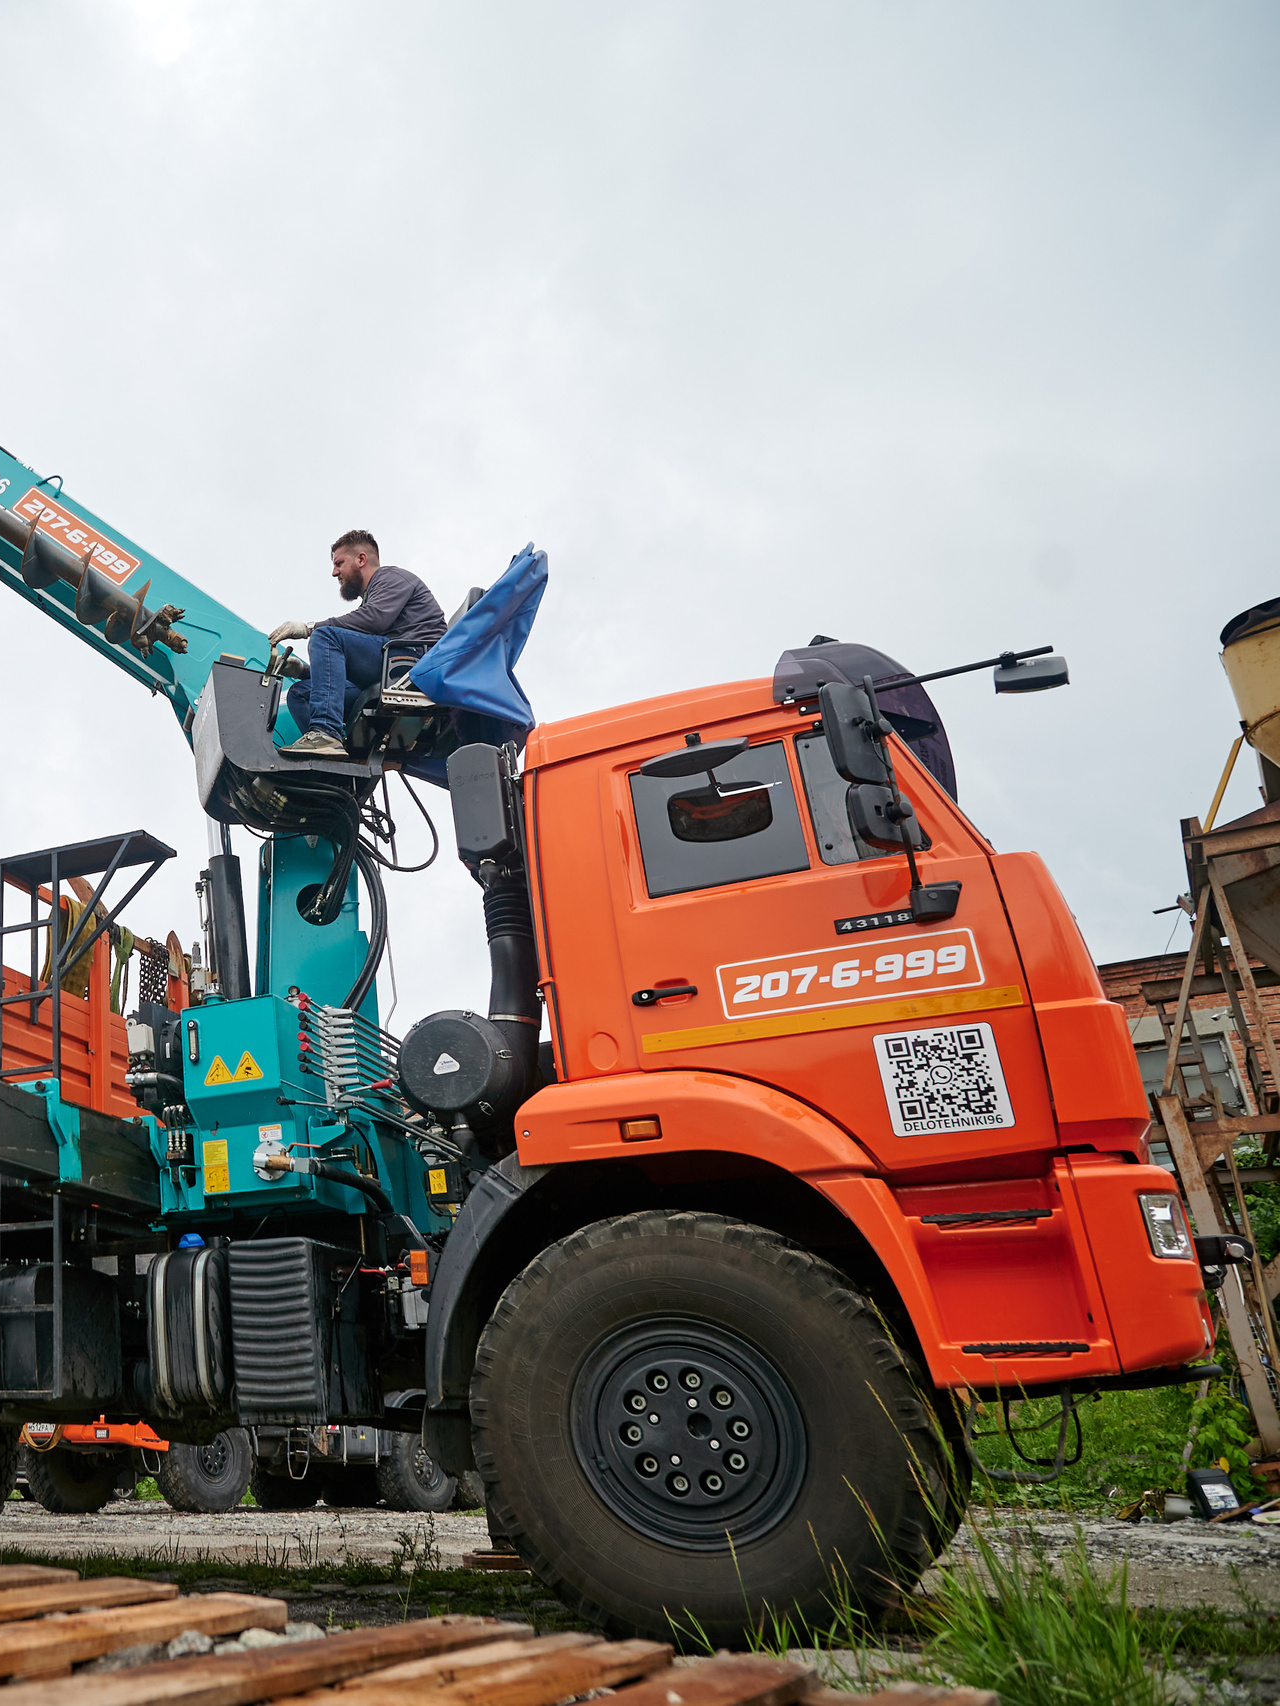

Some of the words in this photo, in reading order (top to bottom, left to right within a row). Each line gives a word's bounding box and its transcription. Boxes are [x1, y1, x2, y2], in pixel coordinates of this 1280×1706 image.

[22, 498, 131, 575] 207-6-999
[841, 912, 910, 930] 43118
[732, 944, 967, 1004] 207-6-999
[903, 1113, 1004, 1132] DELOTEHNIKI96
